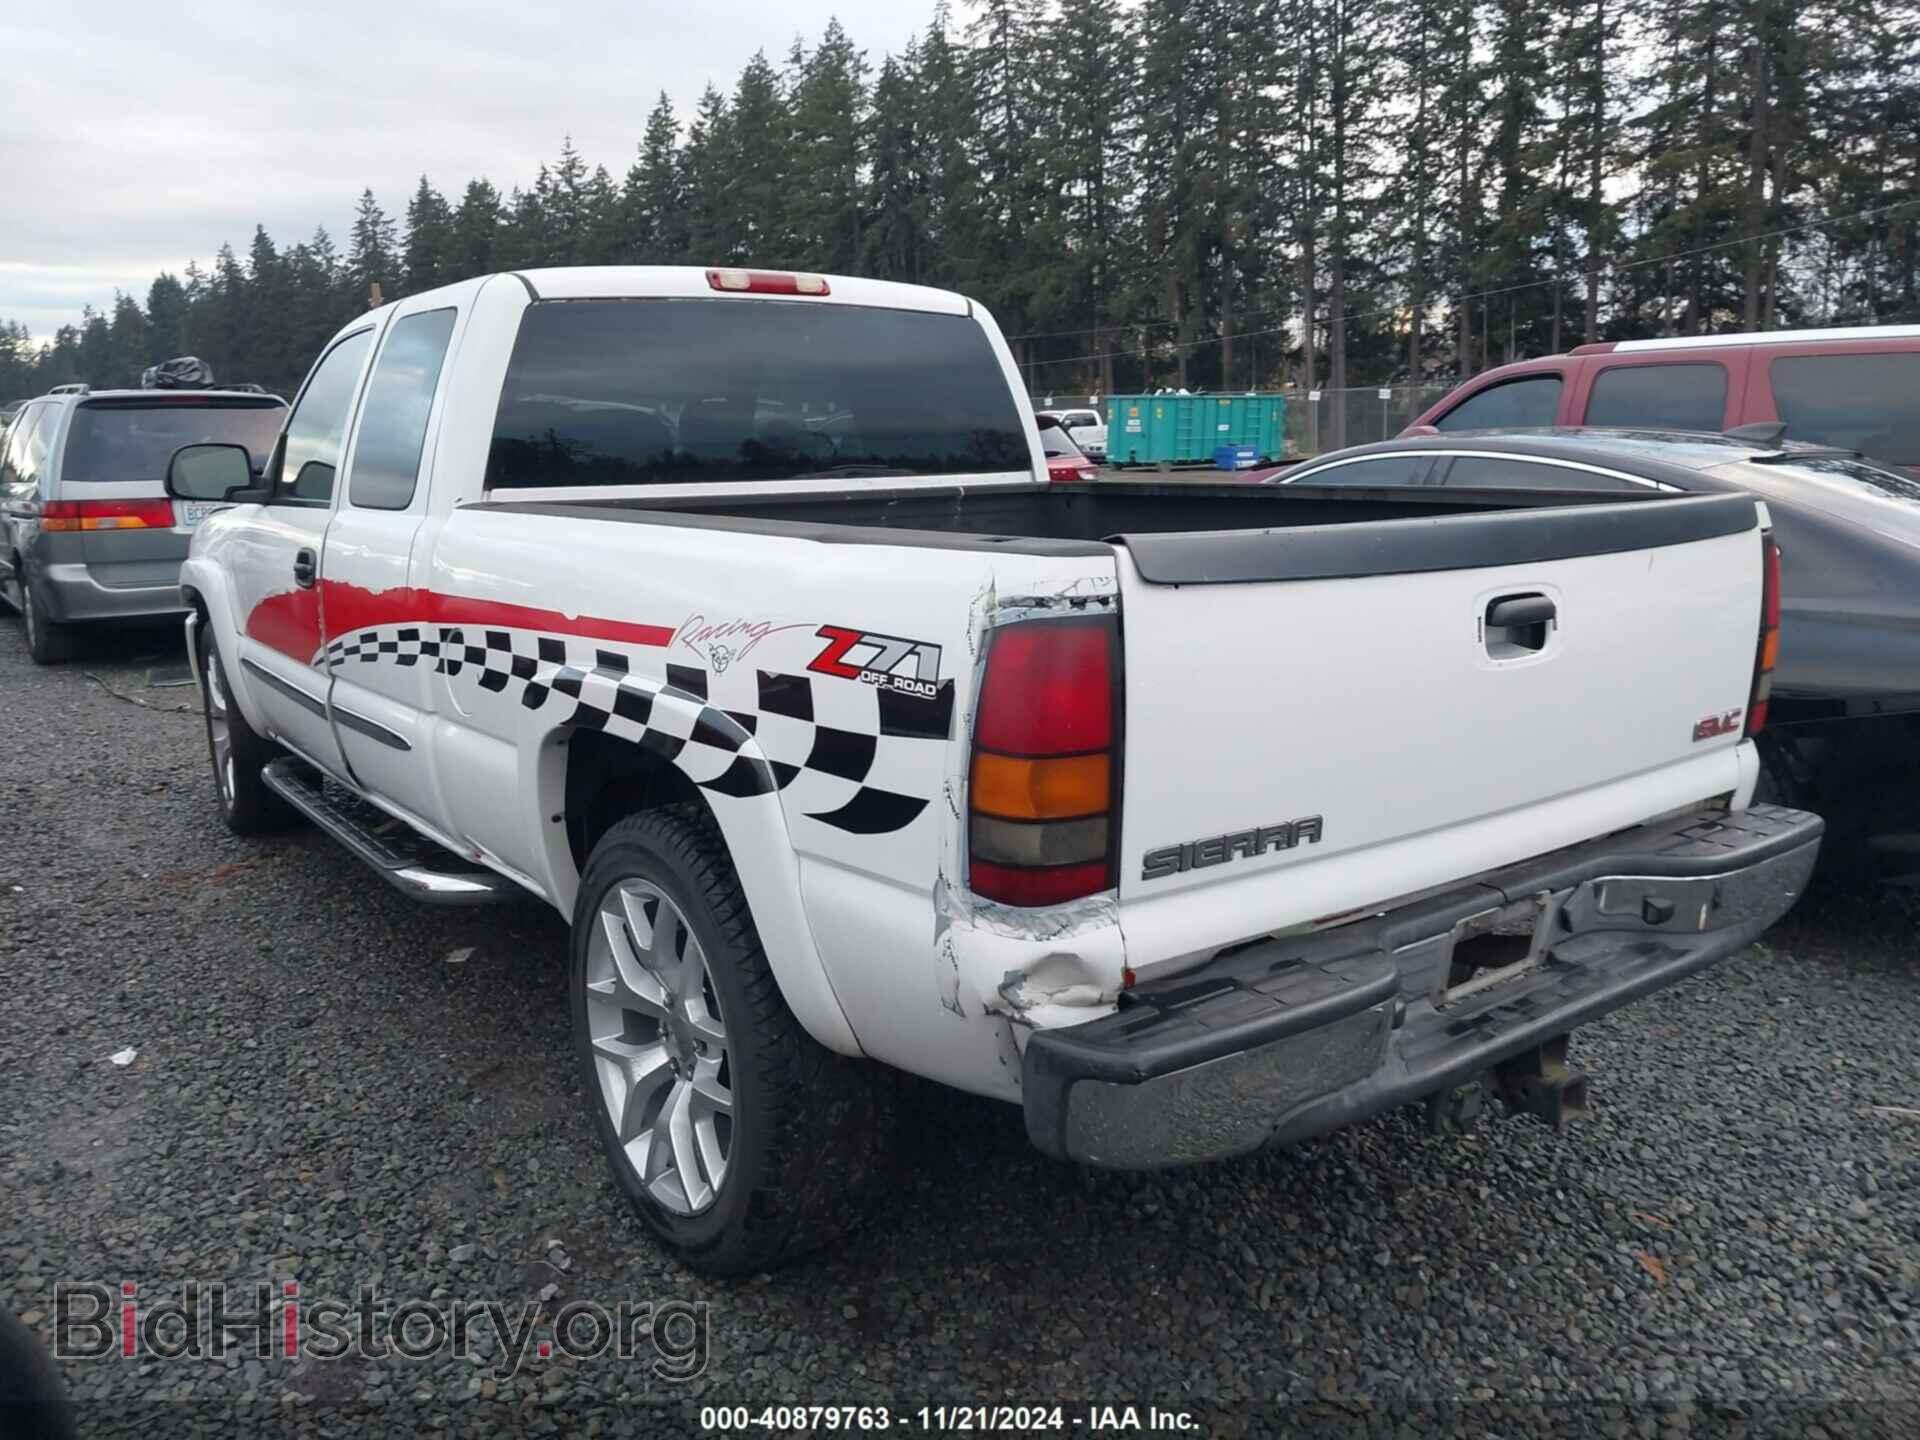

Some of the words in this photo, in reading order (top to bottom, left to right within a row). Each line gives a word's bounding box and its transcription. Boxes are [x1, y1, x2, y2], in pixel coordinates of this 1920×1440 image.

[807, 625, 942, 680] Z71
[860, 669, 888, 684] OFF
[893, 677, 937, 696] ROAD
[1142, 815, 1323, 881] SIERRA
